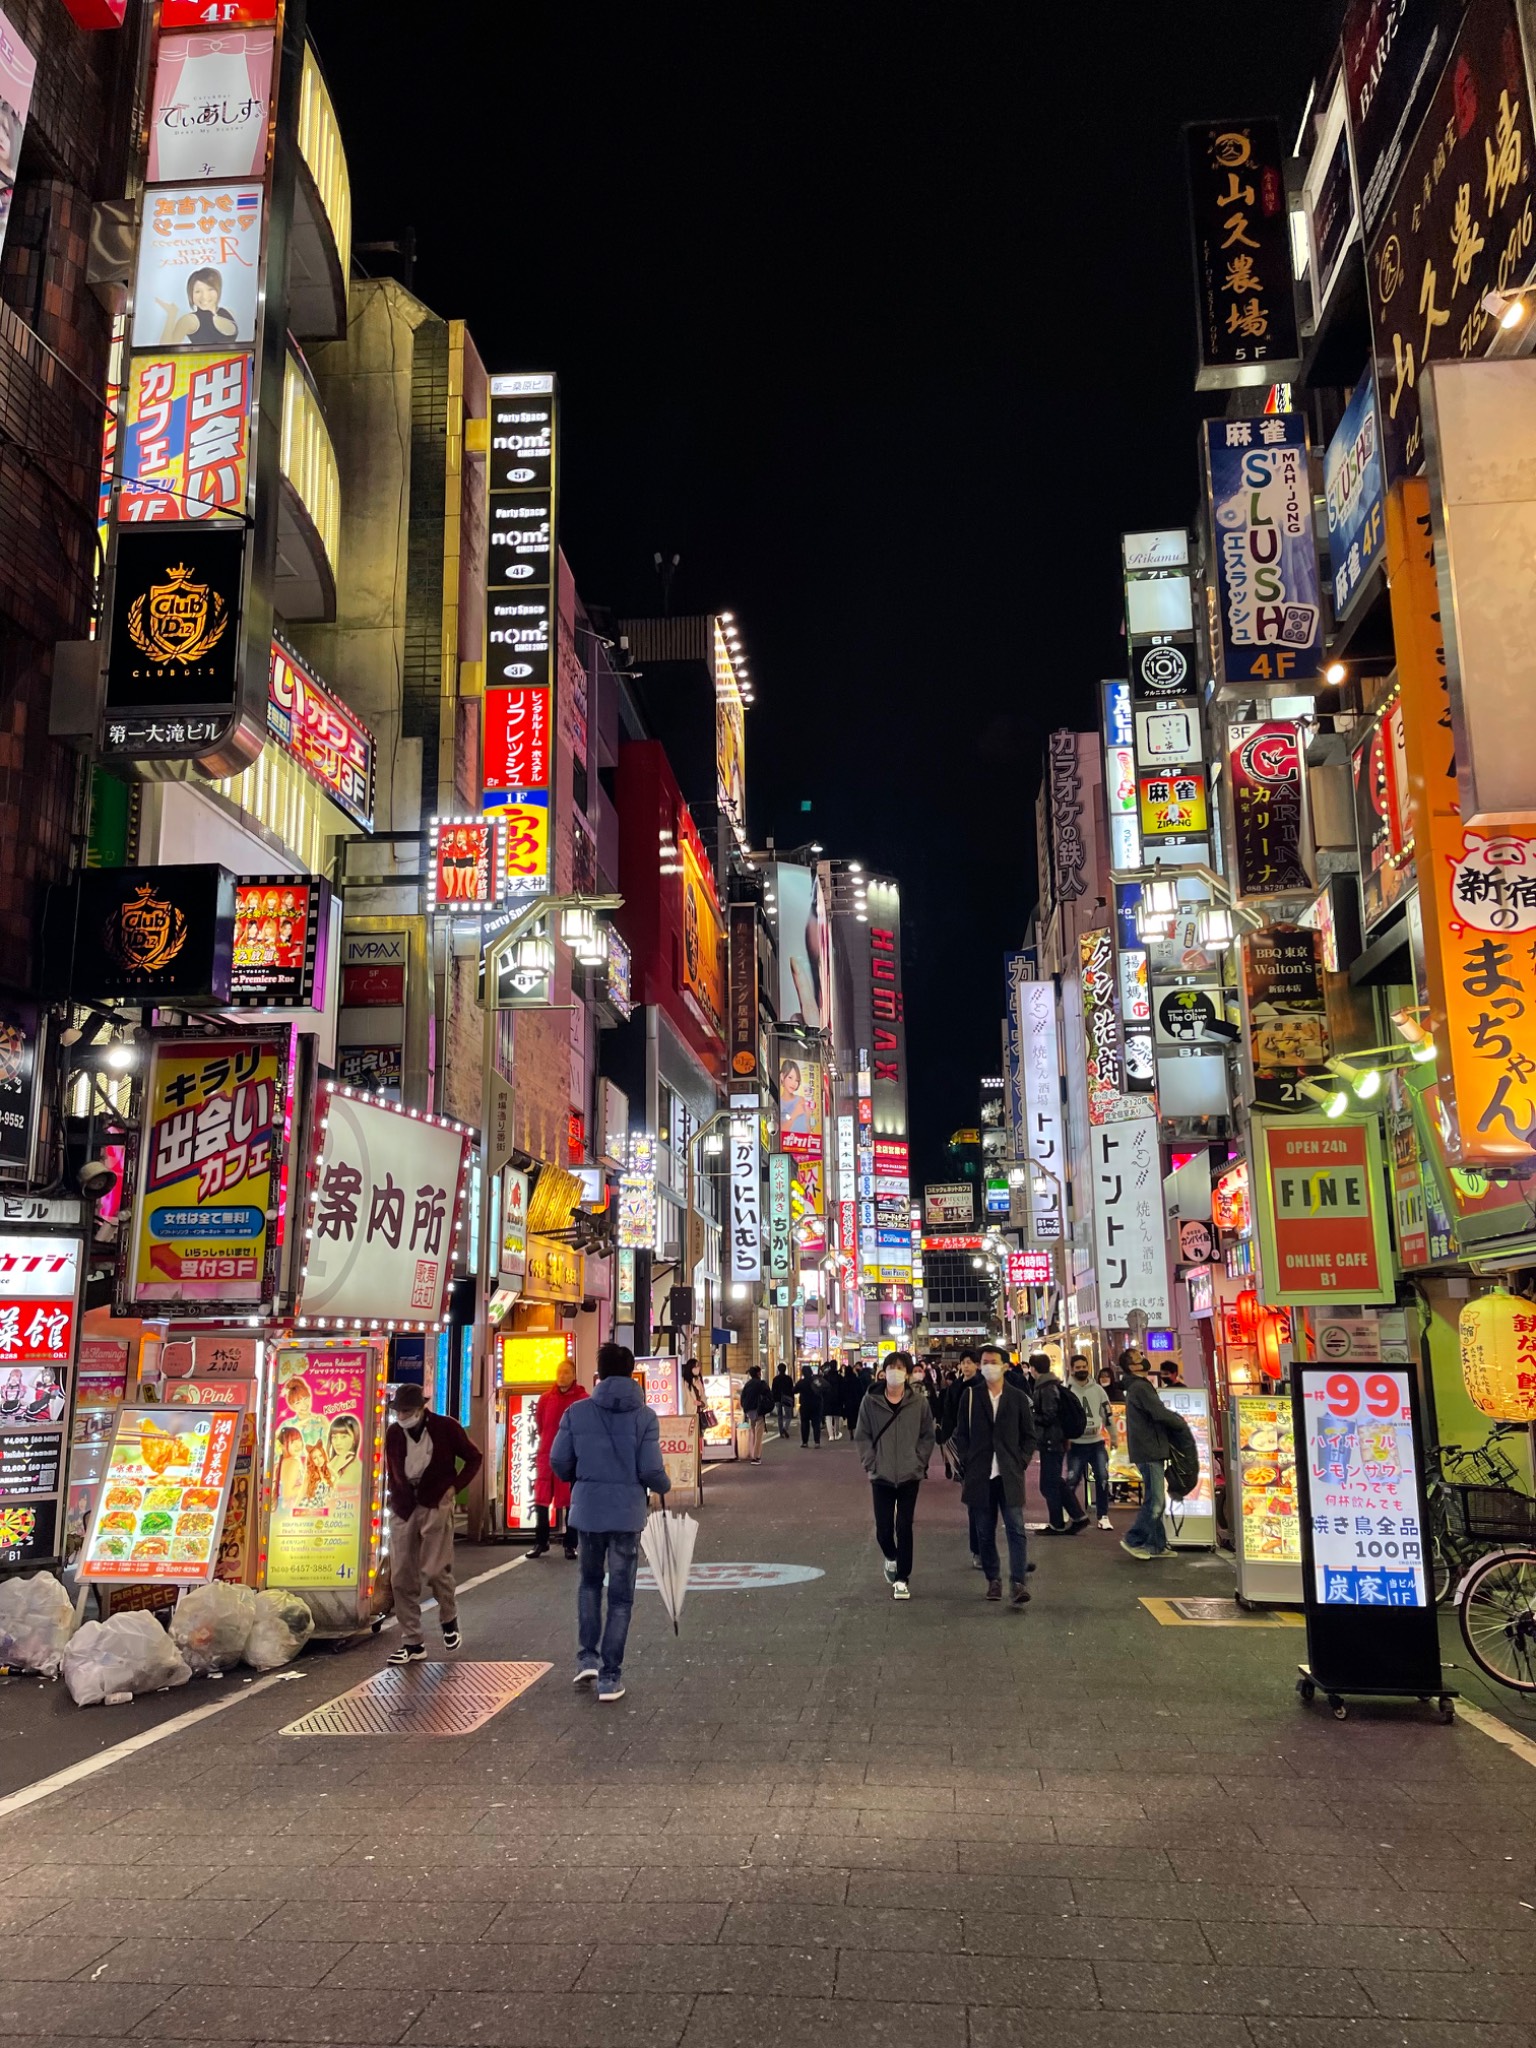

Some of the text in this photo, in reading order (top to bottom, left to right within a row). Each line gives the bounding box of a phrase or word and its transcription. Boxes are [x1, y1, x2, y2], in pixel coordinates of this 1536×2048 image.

[200, 3, 240, 22] 4F
[199, 162, 216, 176] 3F
[1216, 171, 1270, 337] 山久農場
[1234, 346, 1267, 361] 5F
[140, 361, 176, 477] カフェ
[497, 411, 549, 424] Party Space
[186, 359, 246, 520] 出会い
[1225, 419, 1288, 447] 麻雀
[513, 470, 529, 480] 5F
[125, 476, 175, 495] キラリ
[1281, 451, 1301, 534] MAH-JONG
[126, 500, 167, 522] 1F
[495, 507, 547, 519] Party Space
[1362, 501, 1382, 557] 4F
[511, 566, 528, 577] 4F
[1147, 571, 1168, 580] 7F
[1334, 540, 1362, 612] 麻雀
[1226, 534, 1252, 641] エスラッシュ
[152, 594, 207, 618] Club
[493, 604, 546, 616] Party Space
[1151, 635, 1173, 645] 6F
[510, 664, 527, 676] 3F
[1250, 651, 1297, 680] 4F
[1144, 688, 1188, 697] グルニエキッチン
[1155, 701, 1177, 710] 5F
[108, 722, 224, 744] 第一大滝ビル
[505, 690, 526, 787] リフレッシュ
[530, 689, 543, 782] レンタルルーム ホステル
[1231, 727, 1251, 740] 3F
[486, 777, 500, 787] 2F
[1160, 768, 1182, 777] 4F
[340, 761, 366, 804] 3F
[1148, 780, 1197, 803] 麻雀
[506, 791, 528, 804] 1F
[1053, 728, 1088, 901] カラオケの鉄人
[1164, 836, 1187, 845] 3F
[1250, 786, 1278, 884] カリーナ
[476, 827, 490, 901] ワイン飲み放題
[1455, 866, 1536, 913] 新宿
[121, 909, 164, 932] Club
[483, 911, 511, 935] Party
[1490, 906, 1519, 929] の
[348, 941, 400, 959] IMPAX
[1255, 946, 1308, 960] BBQ 東京
[1125, 954, 1142, 1000] 楊媽媽
[1254, 959, 1313, 976] Walton's
[517, 976, 535, 986] B1
[1174, 976, 1197, 985] 1F
[1268, 984, 1302, 994] 新宿本店
[1133, 1003, 1150, 1015] 1F
[1167, 1012, 1208, 1022] The Olive
[1273, 1021, 1304, 1033] 個室
[1264, 1034, 1315, 1048] パーティー
[1461, 938, 1536, 1146] まっちゃん
[1179, 1047, 1203, 1057] B1
[344, 1050, 396, 1077] 出会い
[1031, 1044, 1049, 1081] 焼とん
[163, 1045, 262, 1107] キラリ
[156, 1083, 269, 1176] 出会い
[781, 1133, 822, 1149] ポケパラ
[875, 1144, 907, 1156] 全店営業中
[1286, 1140, 1348, 1155] OPEN 24h
[199, 1138, 272, 1204] カフェ
[1036, 1111, 1058, 1213] トンン
[773, 1158, 786, 1213] 炭火串焼き
[1281, 1176, 1361, 1208] FINE
[4, 1203, 49, 1219] ビル
[316, 1161, 449, 1257] 案内所
[1101, 1133, 1128, 1289] トントン
[734, 1184, 758, 1271] にいむら
[772, 1217, 788, 1271] ちから
[1135, 1200, 1155, 1275] 焼とん 酒場
[1180, 1231, 1211, 1246] カンパイ屋
[180, 1259, 255, 1278] 受付3F
[1010, 1255, 1048, 1268] 24時間
[1285, 1252, 1368, 1269] ONLINE CAFE
[1010, 1268, 1048, 1282] 営業中
[1320, 1272, 1338, 1287] B1
[1104, 1295, 1165, 1310] 新宿歌舞伎町店
[200, 1386, 235, 1403] Pink
[313, 1375, 362, 1398] こゆき
[1303, 1373, 1412, 1420] 一杯 99 円
[197, 1423, 210, 1434] 4F
[203, 1418, 233, 1486] 湖南菜館
[511, 1414, 523, 1505] ファイナルアンサー
[1312, 1464, 1413, 1479] レモンサワー
[1312, 1516, 1419, 1536] 焼き鳥全品
[8, 1550, 22, 1562] B1
[1354, 1540, 1421, 1560] 100円
[335, 1562, 356, 1579] 4F
[1327, 1574, 1387, 1603] 炭家
[1389, 1578, 1417, 1590] 当ビル
[1392, 1592, 1411, 1605] 1F
